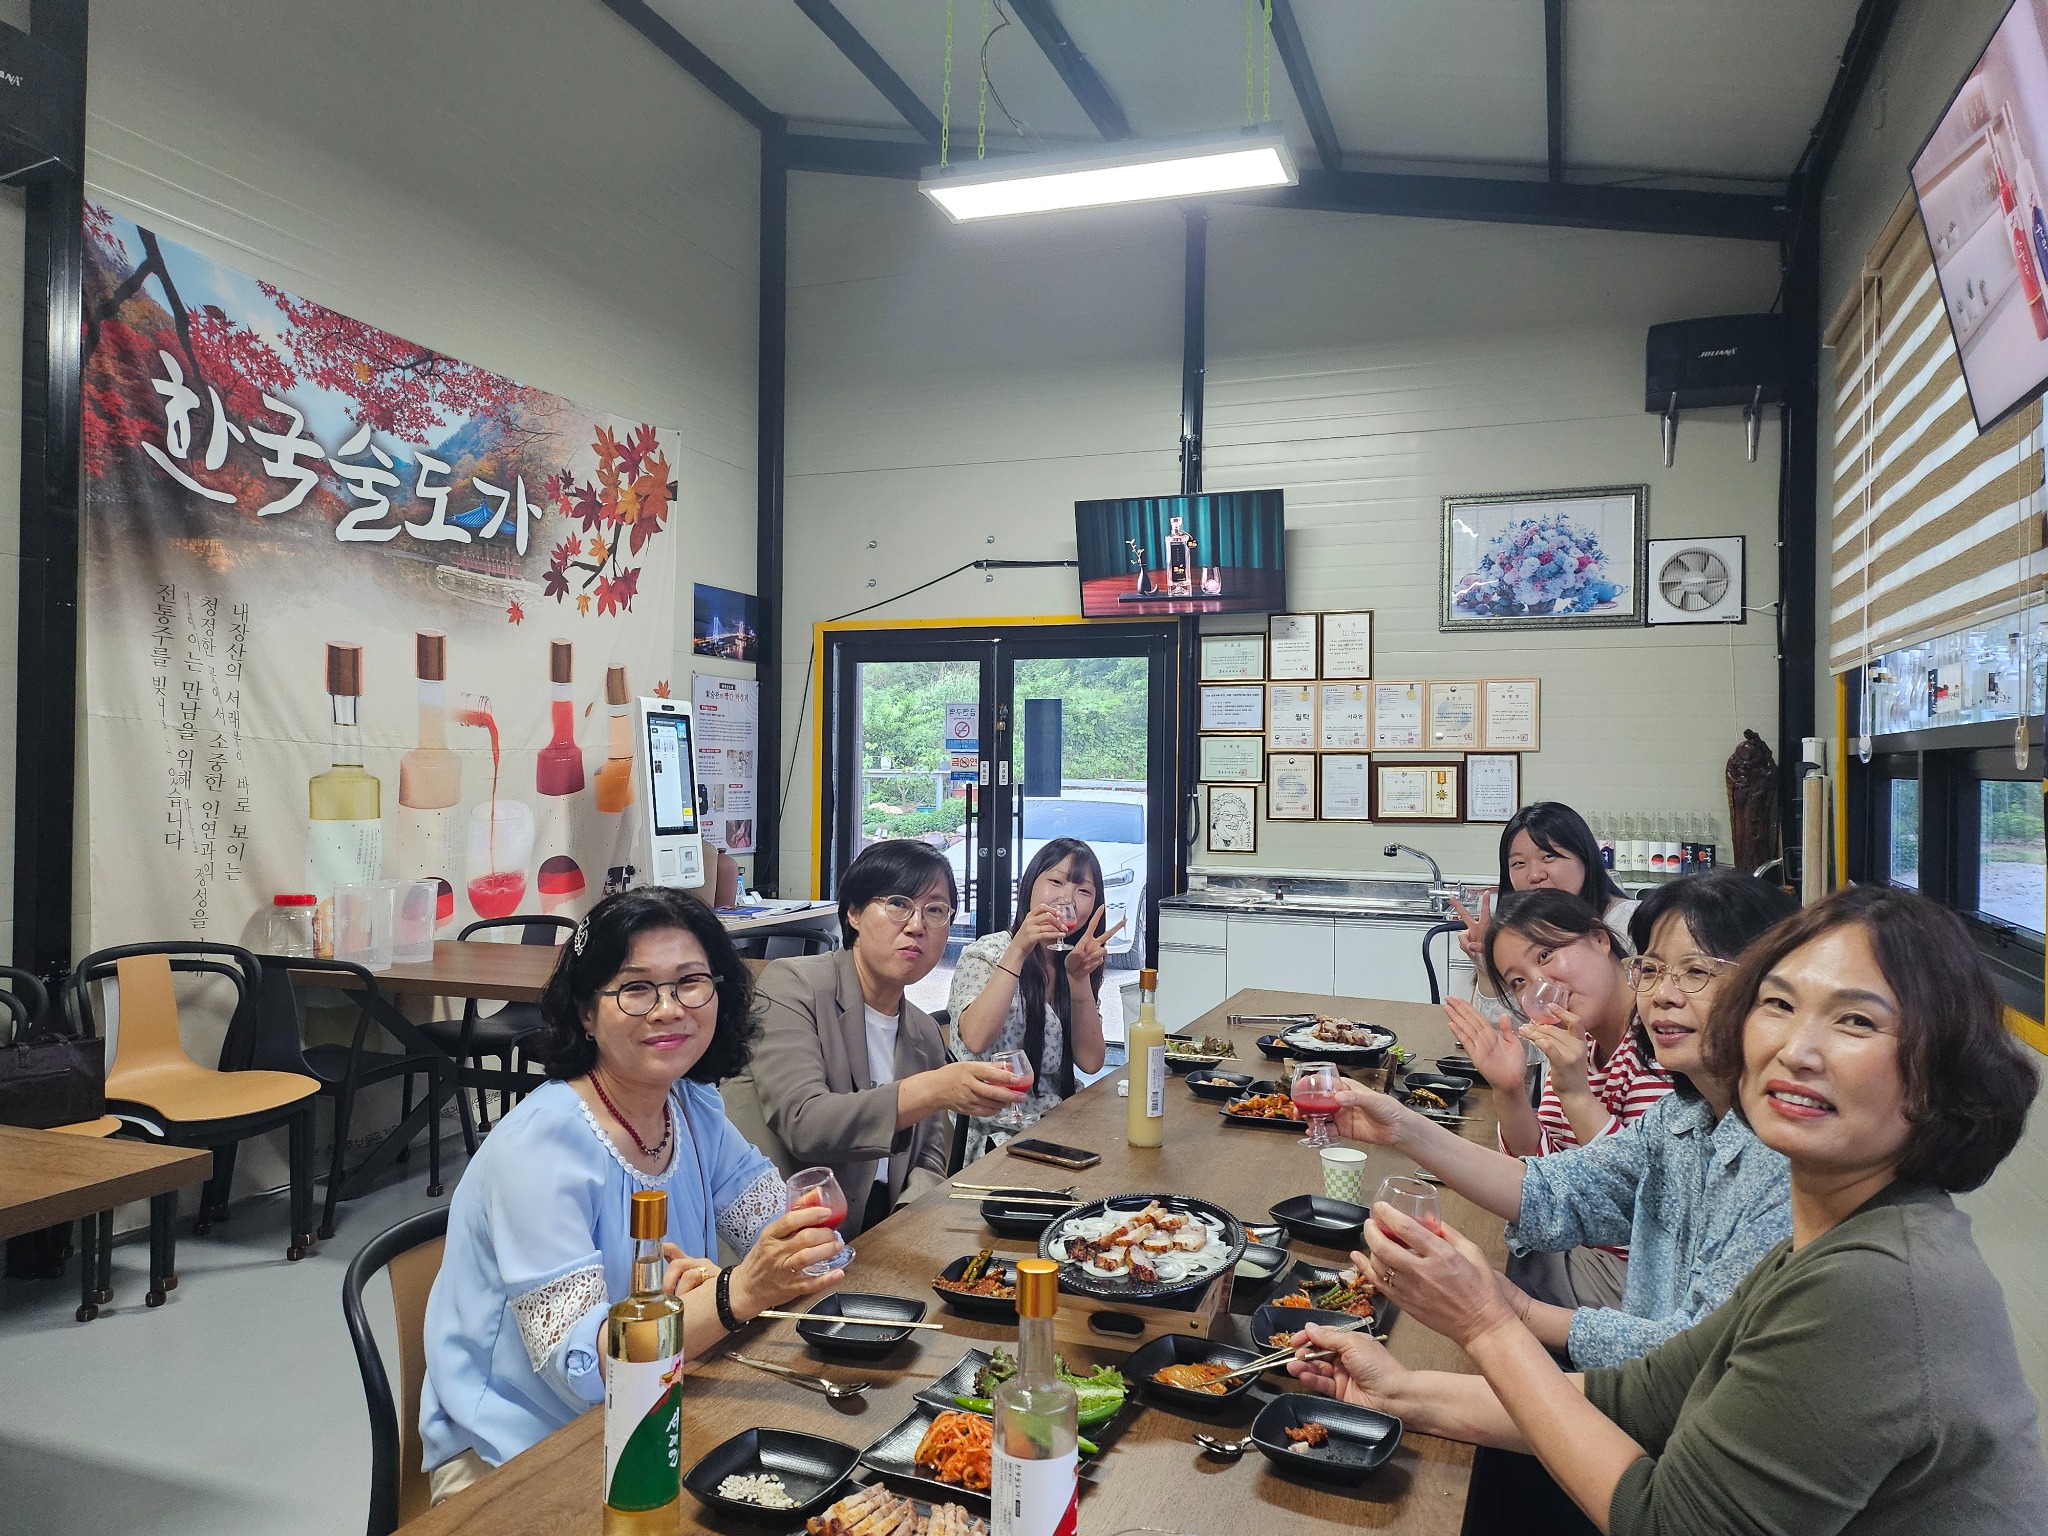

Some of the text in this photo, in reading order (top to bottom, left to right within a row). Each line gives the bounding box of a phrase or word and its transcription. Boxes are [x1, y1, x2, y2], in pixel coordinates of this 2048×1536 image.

[141, 349, 543, 557] 한국술도가
[150, 582, 177, 669] 전통주를
[200, 596, 219, 658] 청정한
[225, 602, 249, 683] 내장산의
[178, 679, 204, 742] 만남을
[177, 748, 194, 791] 위해
[204, 732, 228, 793] 소중한
[200, 799, 220, 882] 인연과의
[224, 823, 249, 882] 보이는
[189, 866, 208, 930] 정성을
